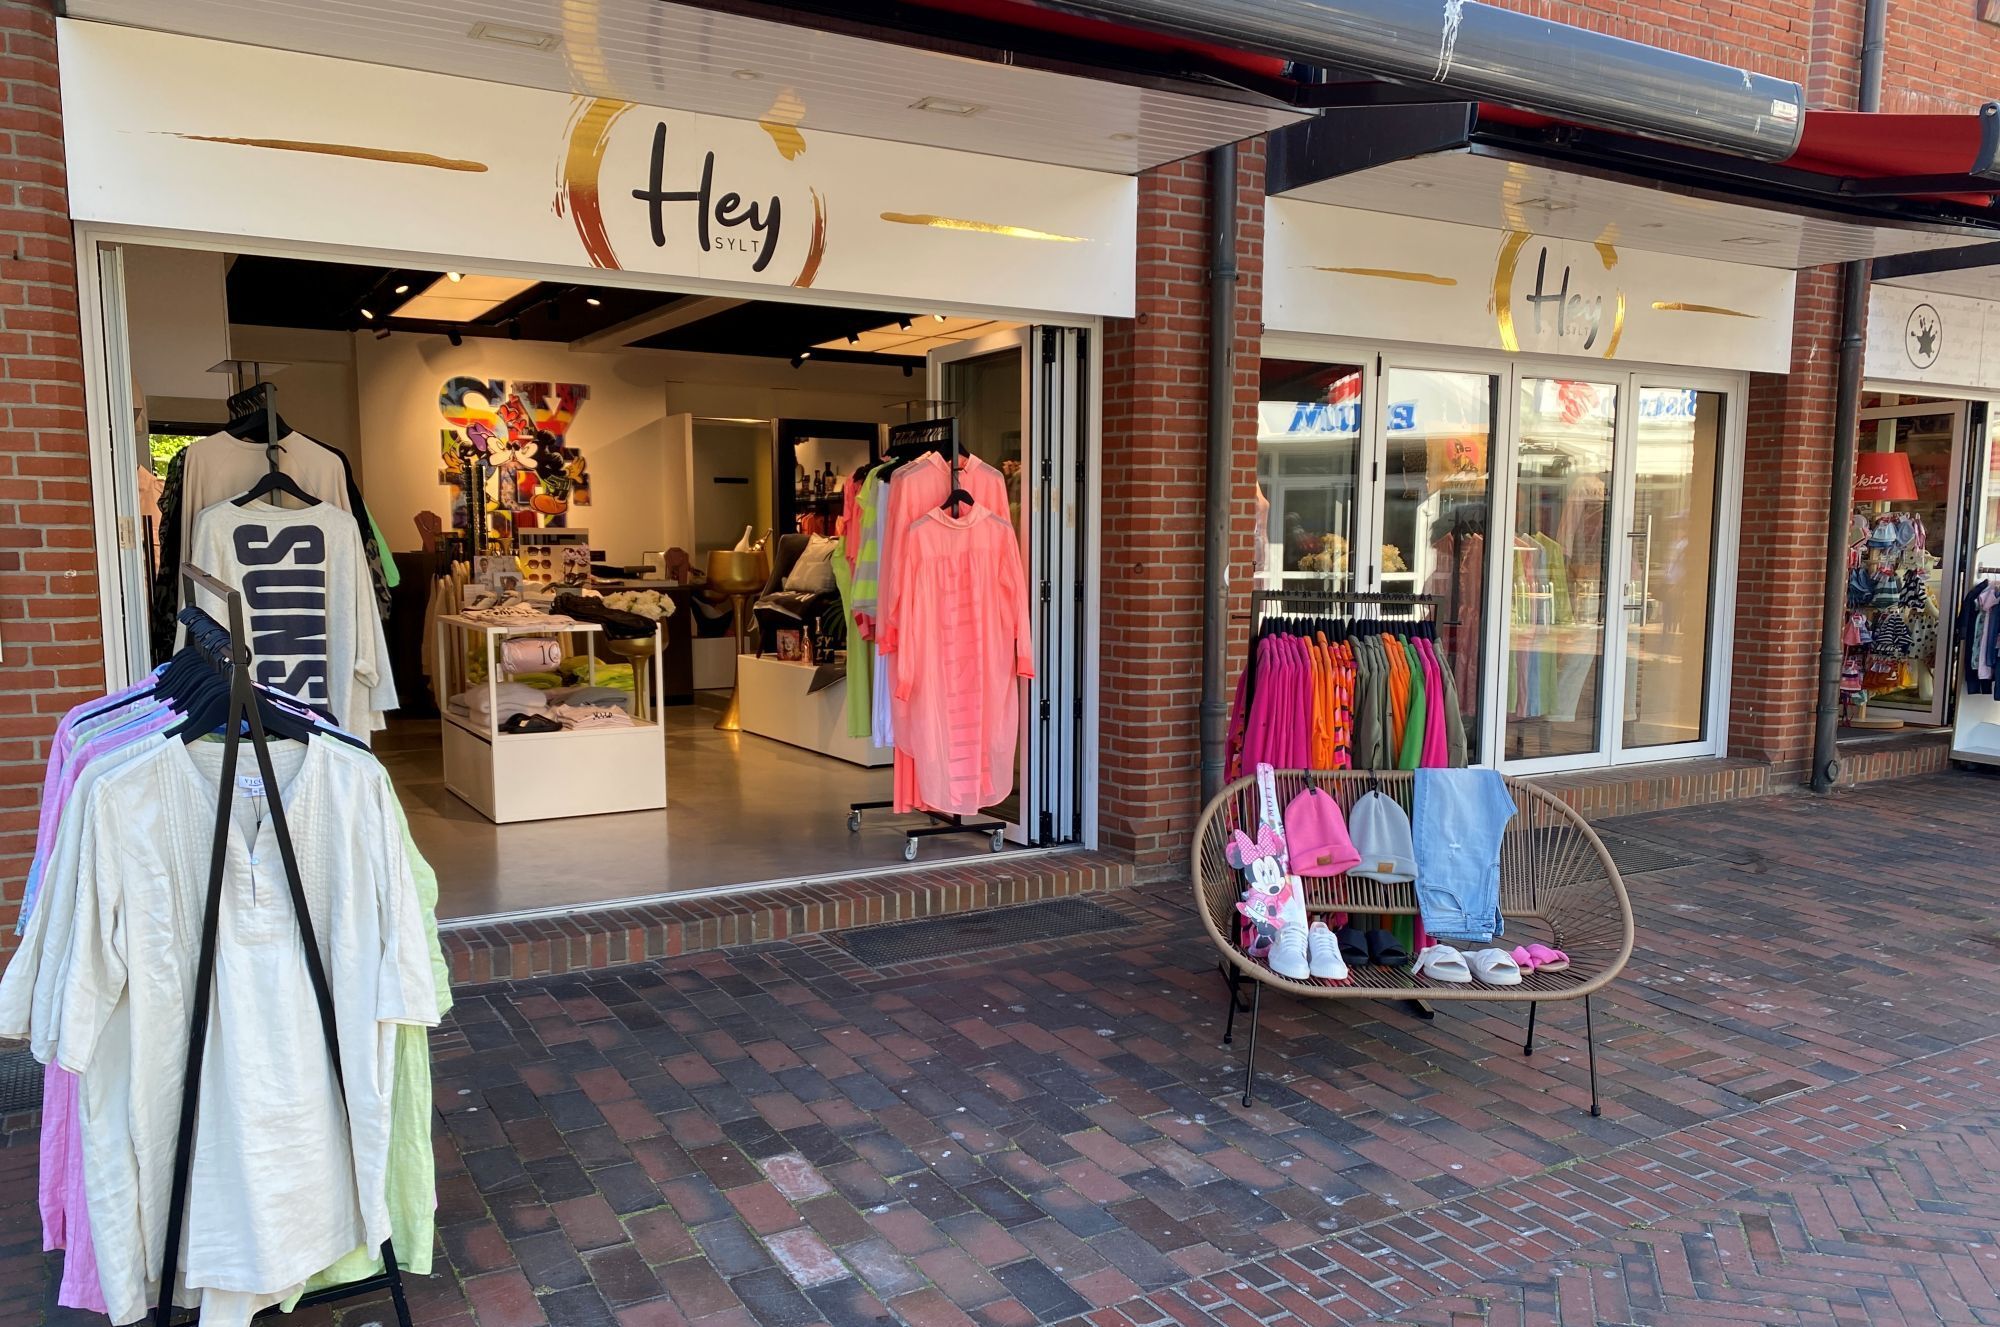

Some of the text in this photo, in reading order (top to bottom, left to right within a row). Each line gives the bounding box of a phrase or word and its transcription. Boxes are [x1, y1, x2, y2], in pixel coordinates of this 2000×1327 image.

[632, 121, 781, 272] Hey
[715, 236, 760, 253] SYLT
[1526, 246, 1602, 350] Hey
[1855, 473, 1889, 487] kid
[233, 524, 328, 711] SUNS
